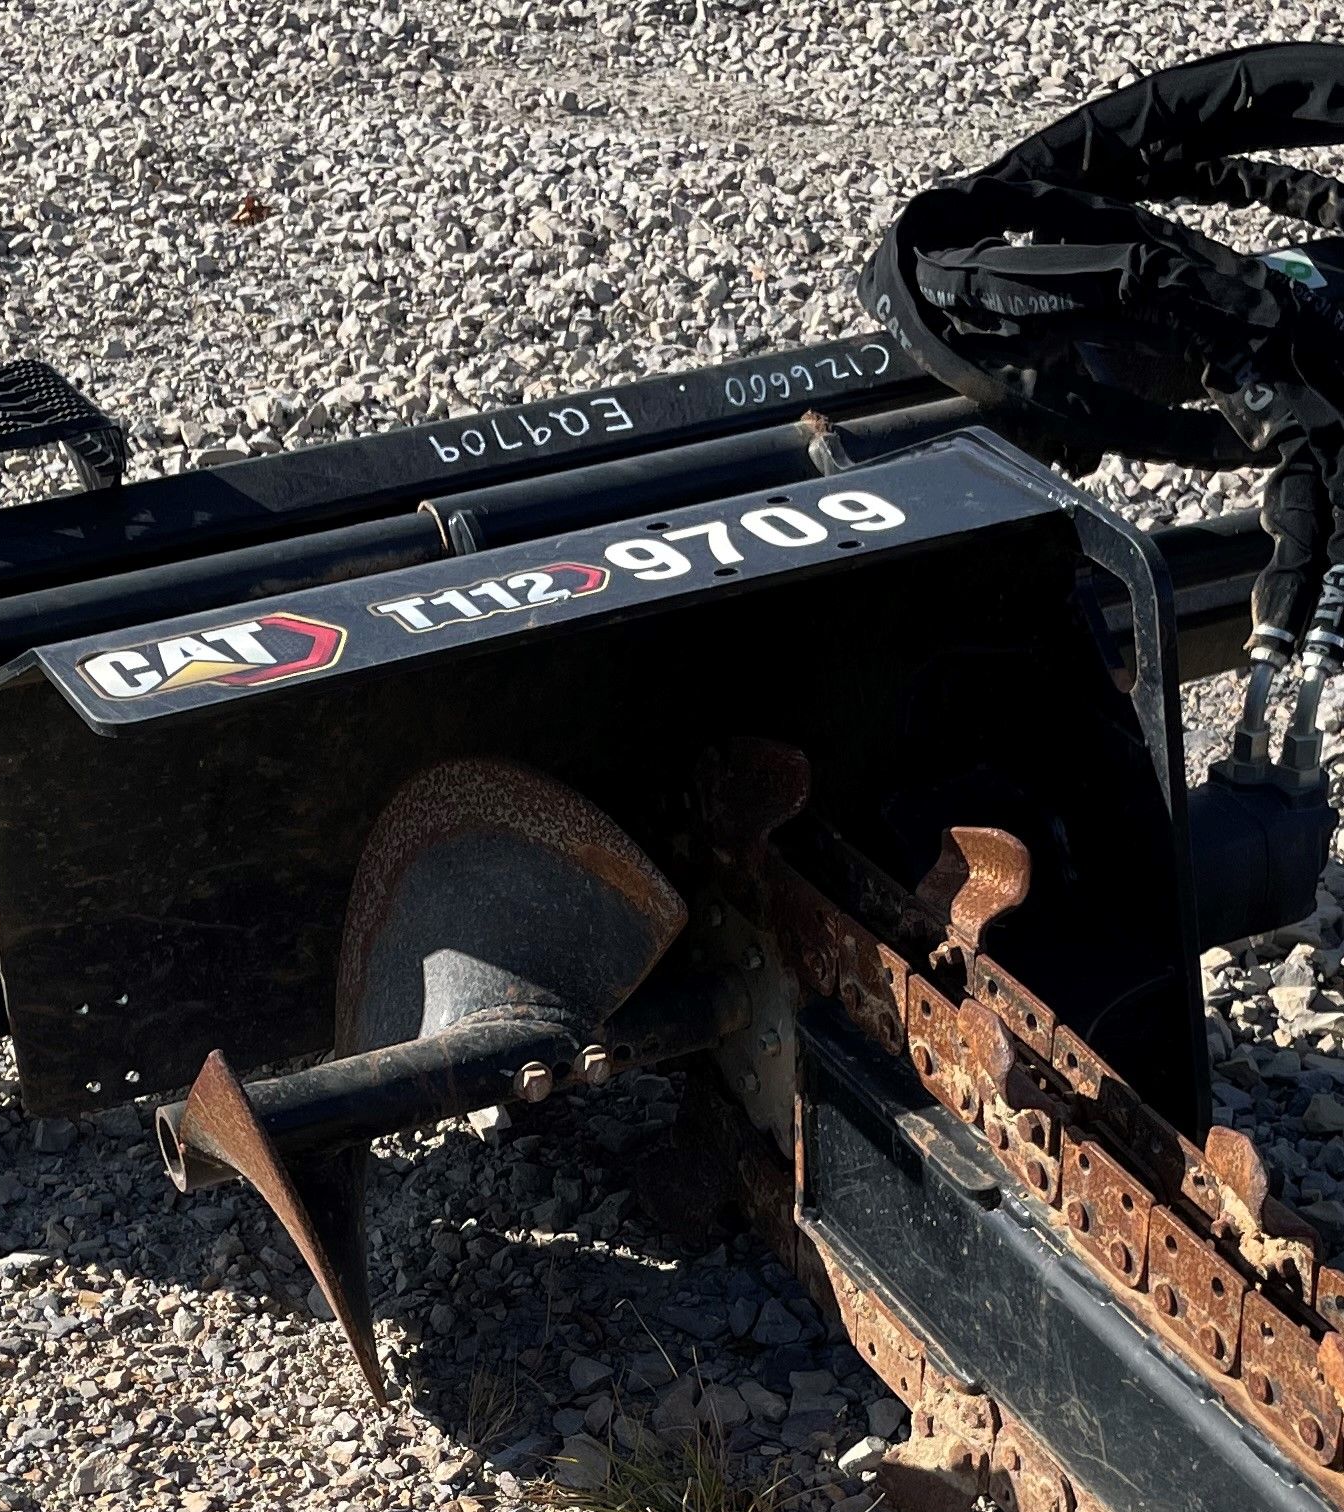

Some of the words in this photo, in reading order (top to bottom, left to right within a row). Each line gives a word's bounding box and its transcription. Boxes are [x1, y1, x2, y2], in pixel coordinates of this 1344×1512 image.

[877, 294, 913, 350] CAT
[429, 397, 634, 463] EQ9709
[83, 617, 280, 700] CAT
[376, 570, 572, 631] T112
[602, 489, 908, 583] 9709
